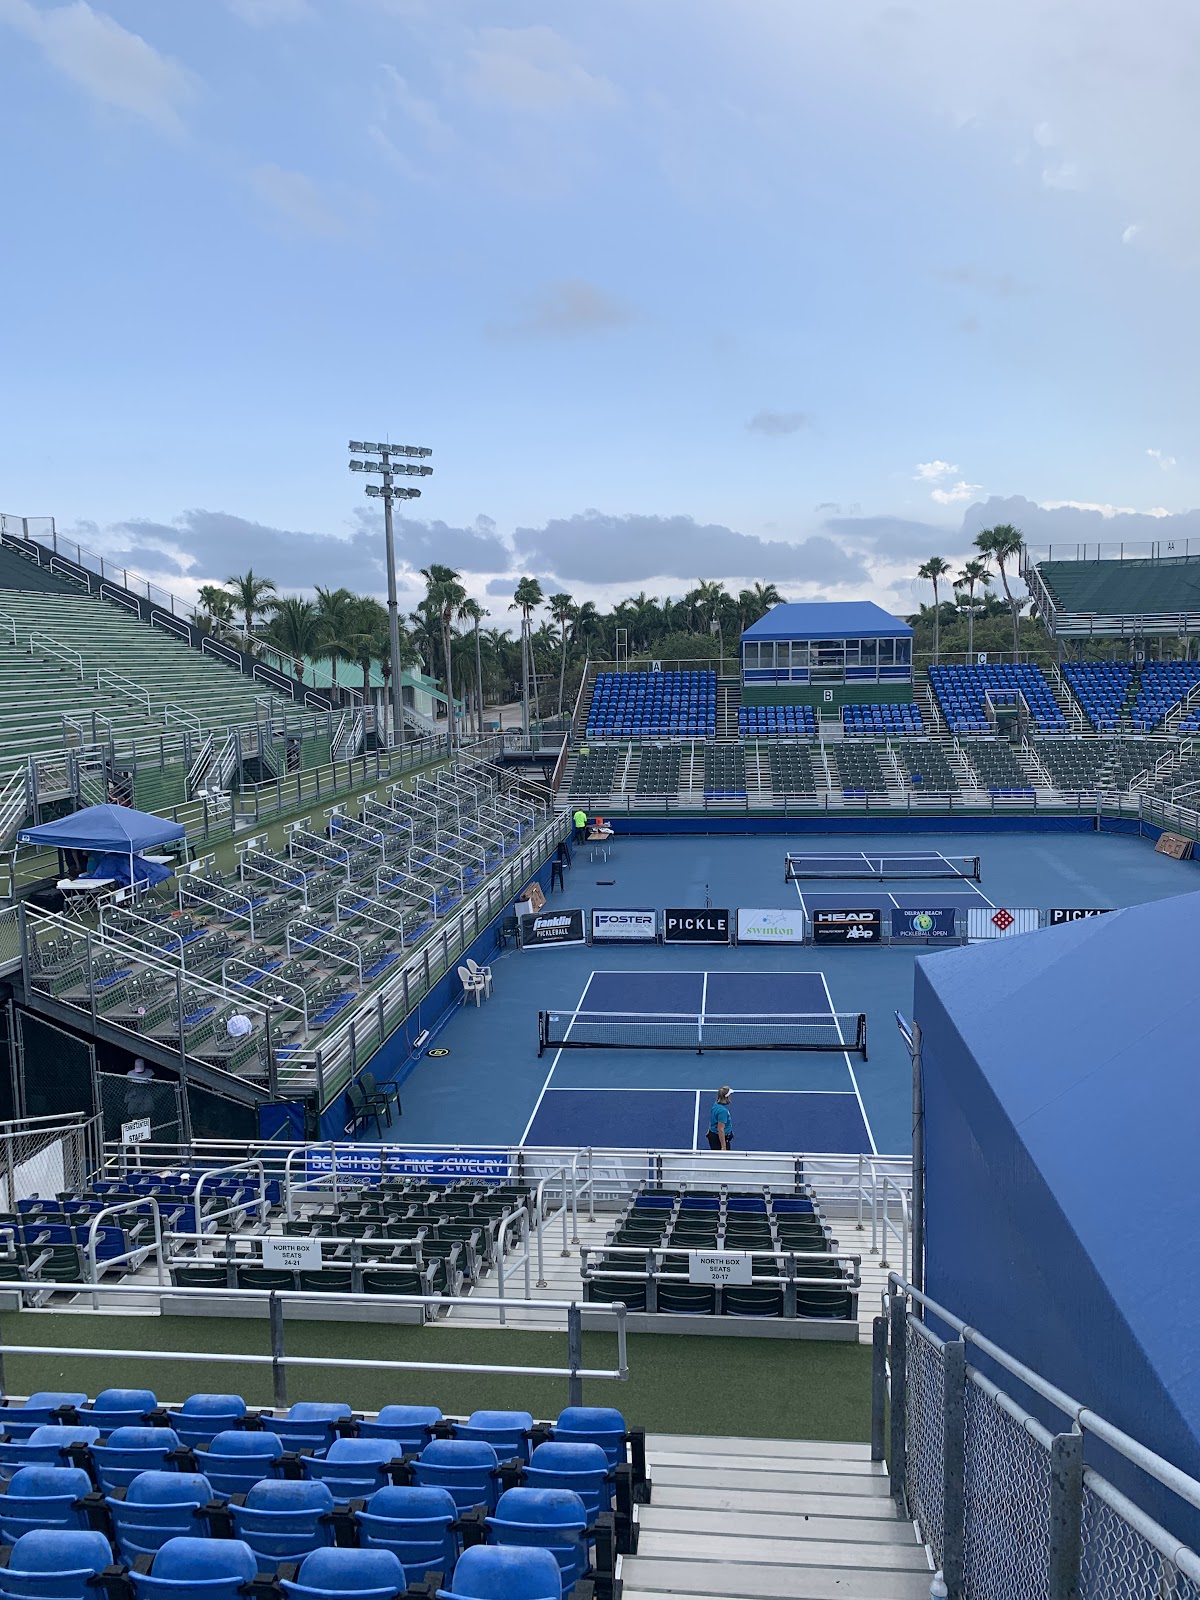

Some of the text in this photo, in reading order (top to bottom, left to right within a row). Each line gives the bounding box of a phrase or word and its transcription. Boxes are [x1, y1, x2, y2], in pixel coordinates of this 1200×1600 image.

[979, 653, 986, 664] C
[1136, 651, 1144, 661] D
[653, 661, 660, 671] A
[824, 690, 832, 701] B
[818, 913, 874, 921] HEAD
[1054, 910, 1101, 922] PICK
[595, 915, 652, 928] FOSTER
[668, 918, 726, 931] PICKLE
[536, 928, 569, 938] PICKLEBALL
[746, 926, 794, 936] swinton
[129, 1132, 144, 1142] STAFF
[312, 1155, 503, 1173] BEACH BOZ FINE JEWELRY
